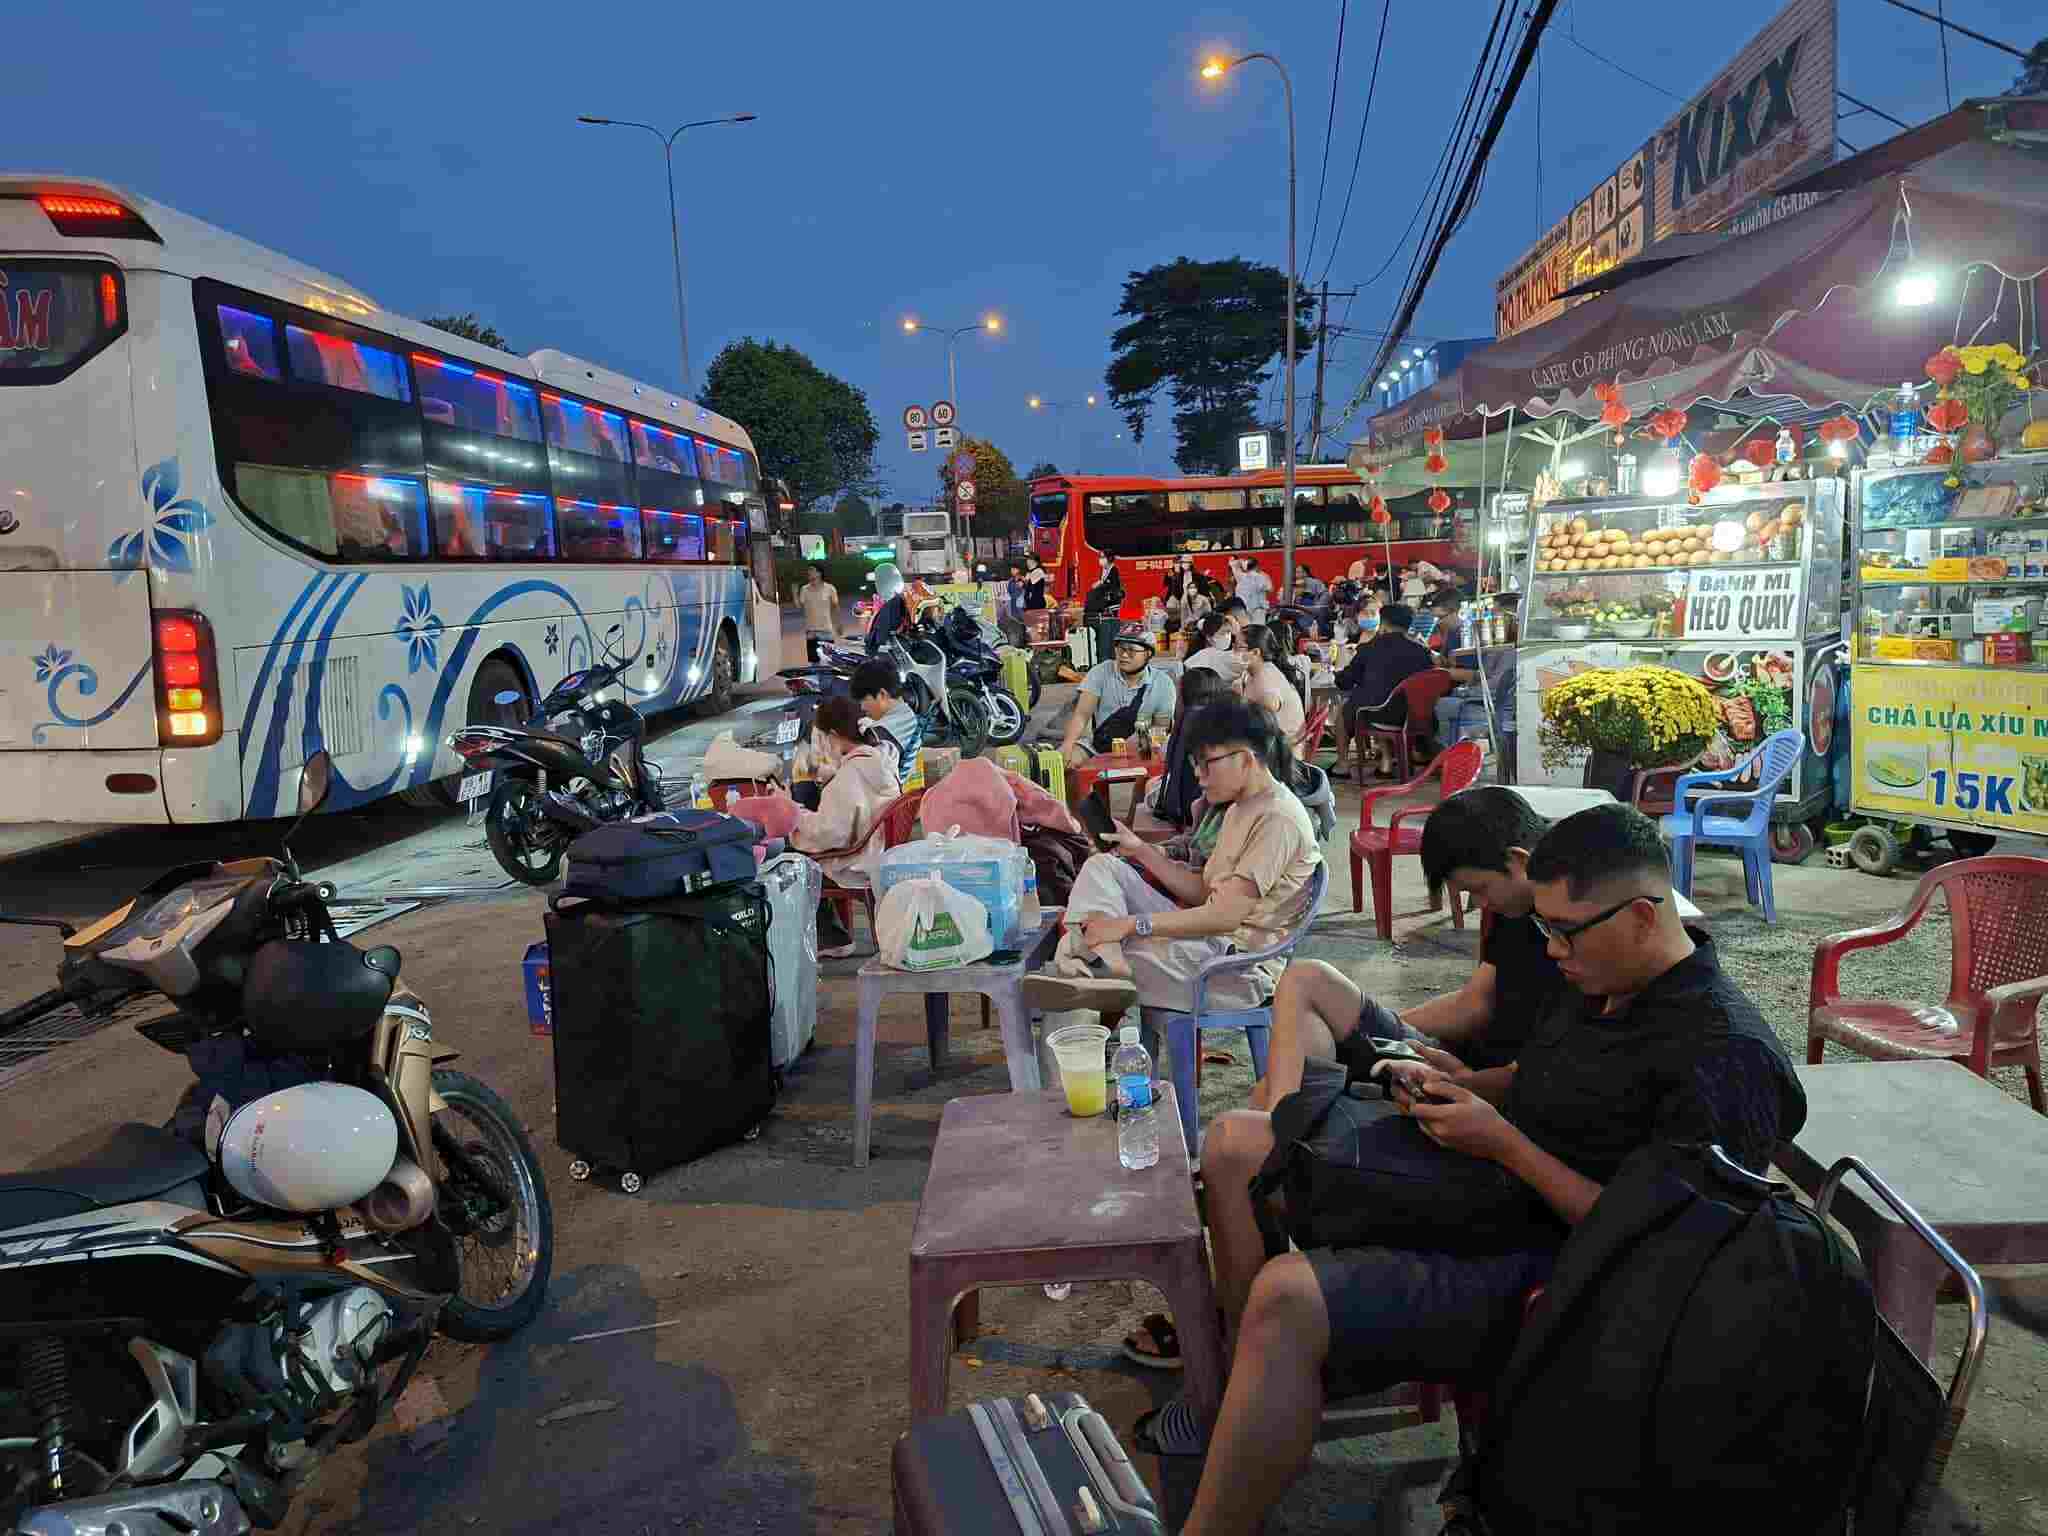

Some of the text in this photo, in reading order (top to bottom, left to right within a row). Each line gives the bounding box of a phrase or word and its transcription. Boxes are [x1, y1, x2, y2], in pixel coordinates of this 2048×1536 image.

[1689, 593, 1796, 634] HEO QUAY
[1930, 769, 2016, 815] 15K
